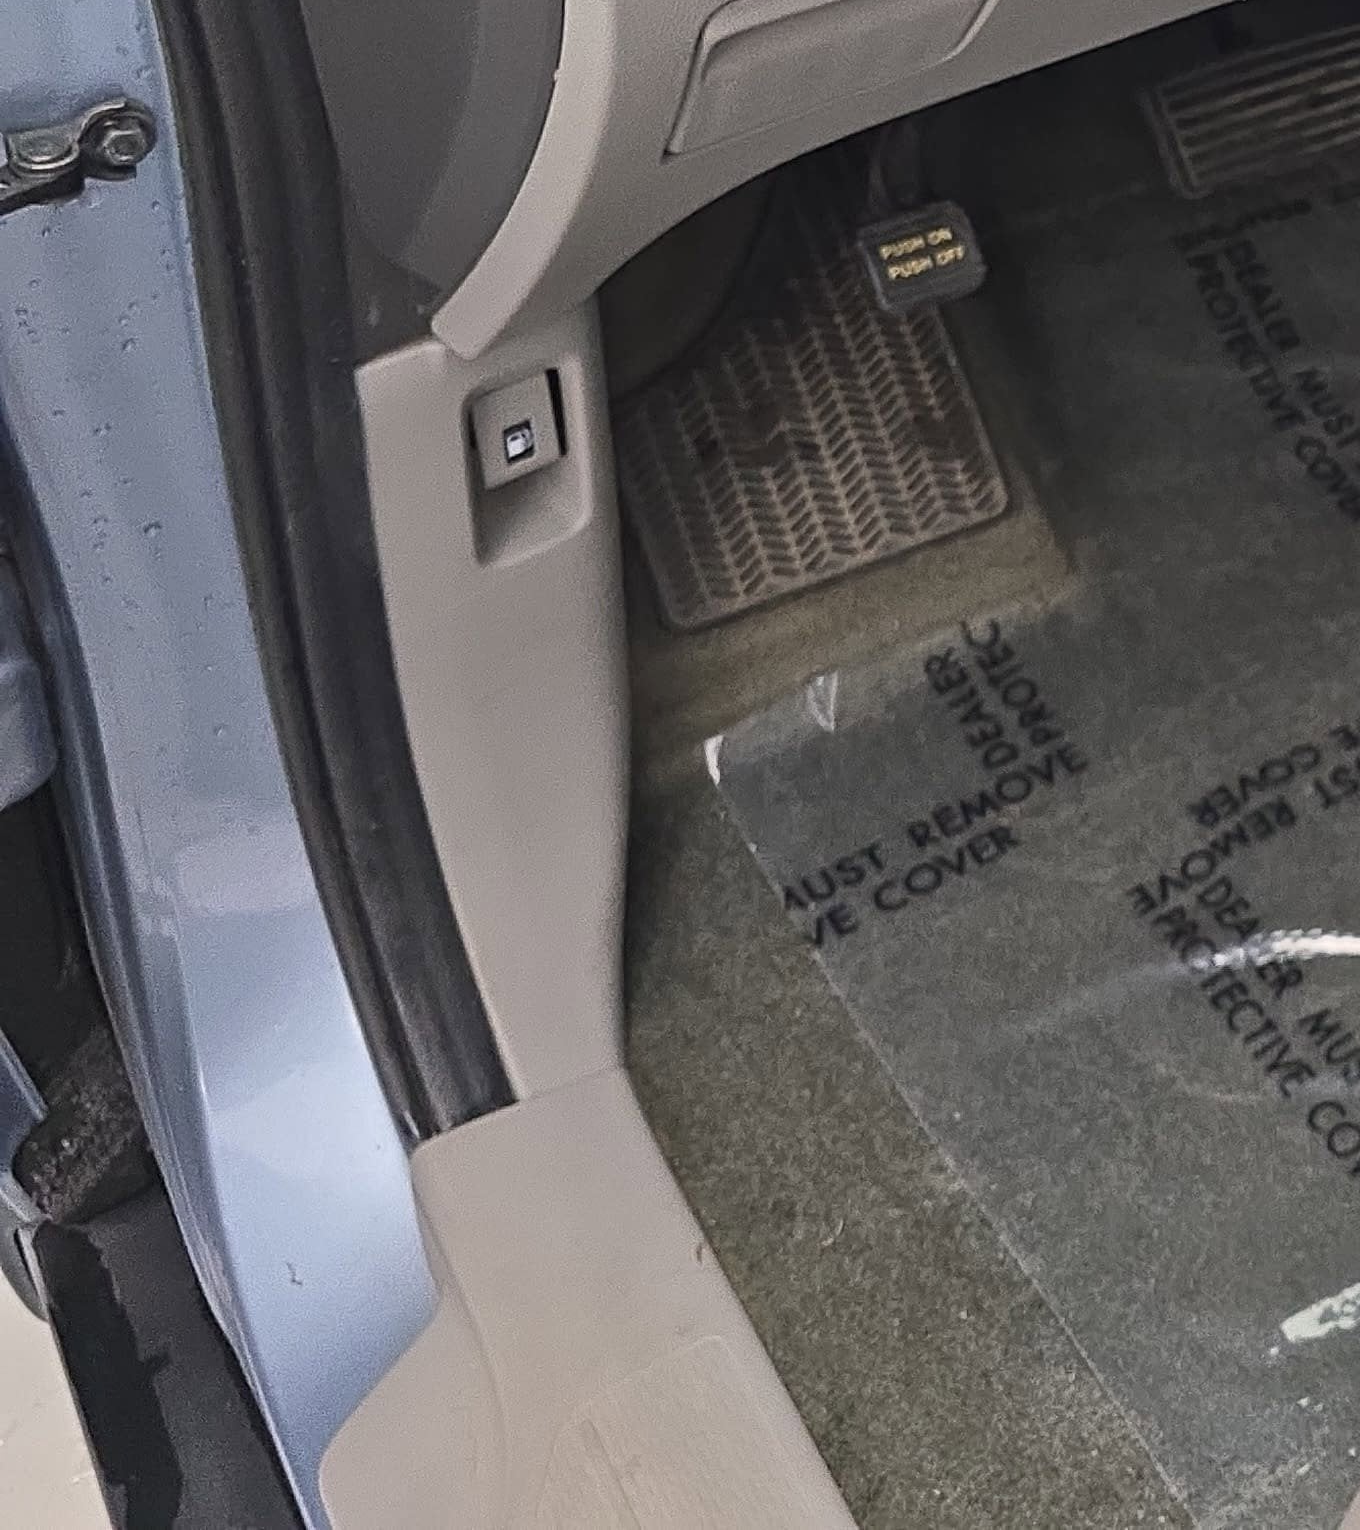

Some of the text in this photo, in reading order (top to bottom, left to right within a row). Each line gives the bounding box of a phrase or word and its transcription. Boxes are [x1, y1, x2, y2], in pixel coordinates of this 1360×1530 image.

[924, 646, 1019, 768] DEALER
[908, 742, 1089, 849] REMOVE
[1186, 742, 1322, 828] COVER
[873, 825, 1020, 912] COVER
[1126, 796, 1297, 918] REMOVE
